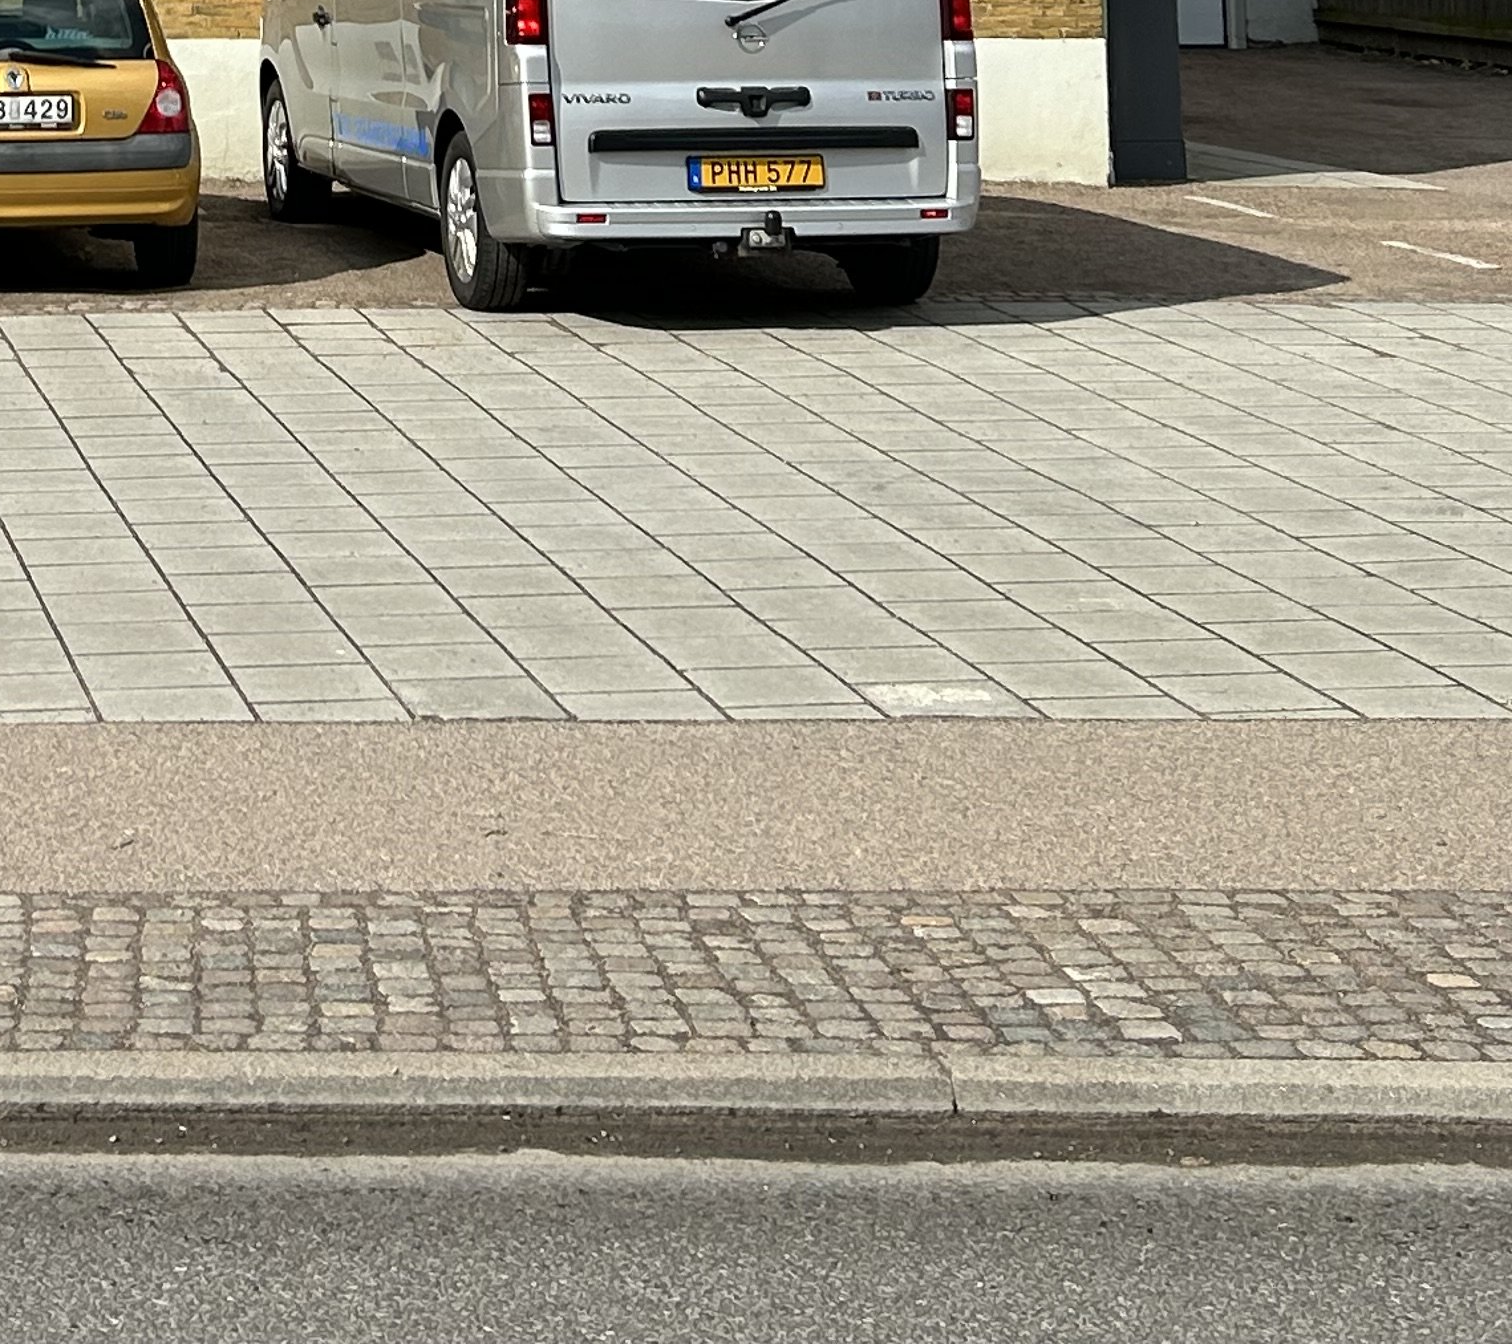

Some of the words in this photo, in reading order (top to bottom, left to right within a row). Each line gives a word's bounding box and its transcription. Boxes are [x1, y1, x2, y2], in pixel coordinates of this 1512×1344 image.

[24, 98, 69, 120] 429
[562, 93, 632, 104] VIVARO
[711, 161, 758, 184] PHH
[767, 160, 812, 183] 577
